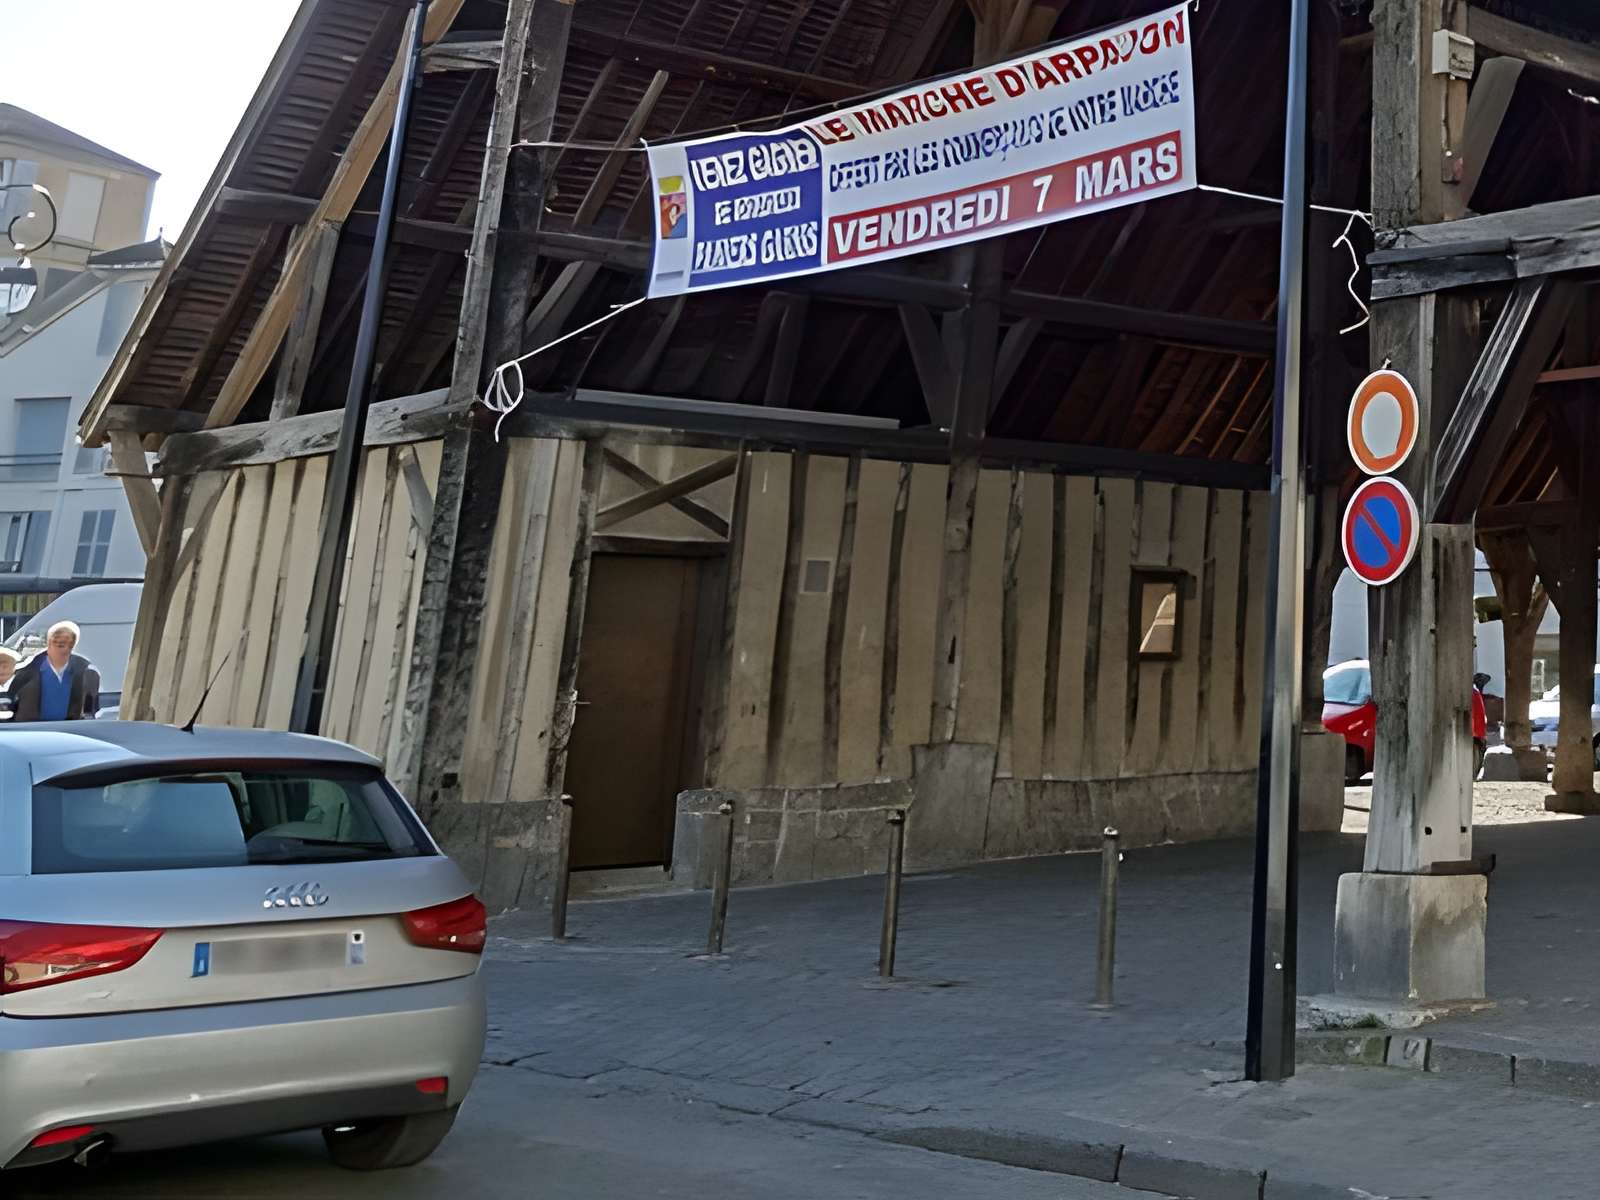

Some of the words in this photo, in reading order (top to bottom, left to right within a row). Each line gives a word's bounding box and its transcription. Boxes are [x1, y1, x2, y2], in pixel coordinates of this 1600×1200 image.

[804, 118, 855, 145] LE
[833, 185, 1011, 255] VENDREDI
[1033, 174, 1053, 213] 7
[1075, 141, 1179, 203] MARS
